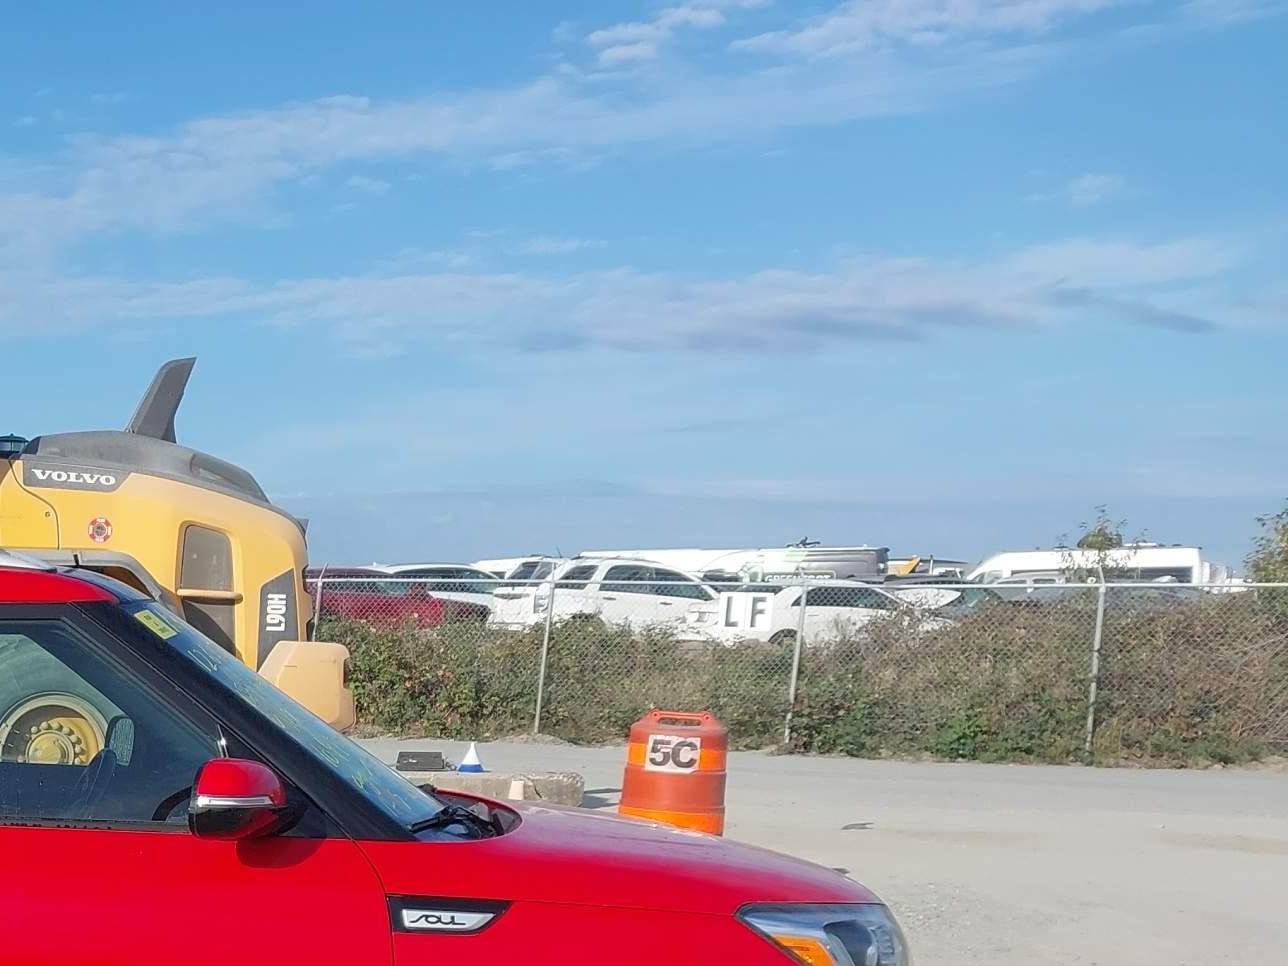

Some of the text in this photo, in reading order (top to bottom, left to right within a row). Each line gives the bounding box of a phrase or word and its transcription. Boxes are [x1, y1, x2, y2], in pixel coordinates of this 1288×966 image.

[31, 468, 116, 486] VOLVO
[265, 593, 287, 632] L90H
[649, 738, 698, 768] 5C
[409, 914, 467, 926] SOUL
